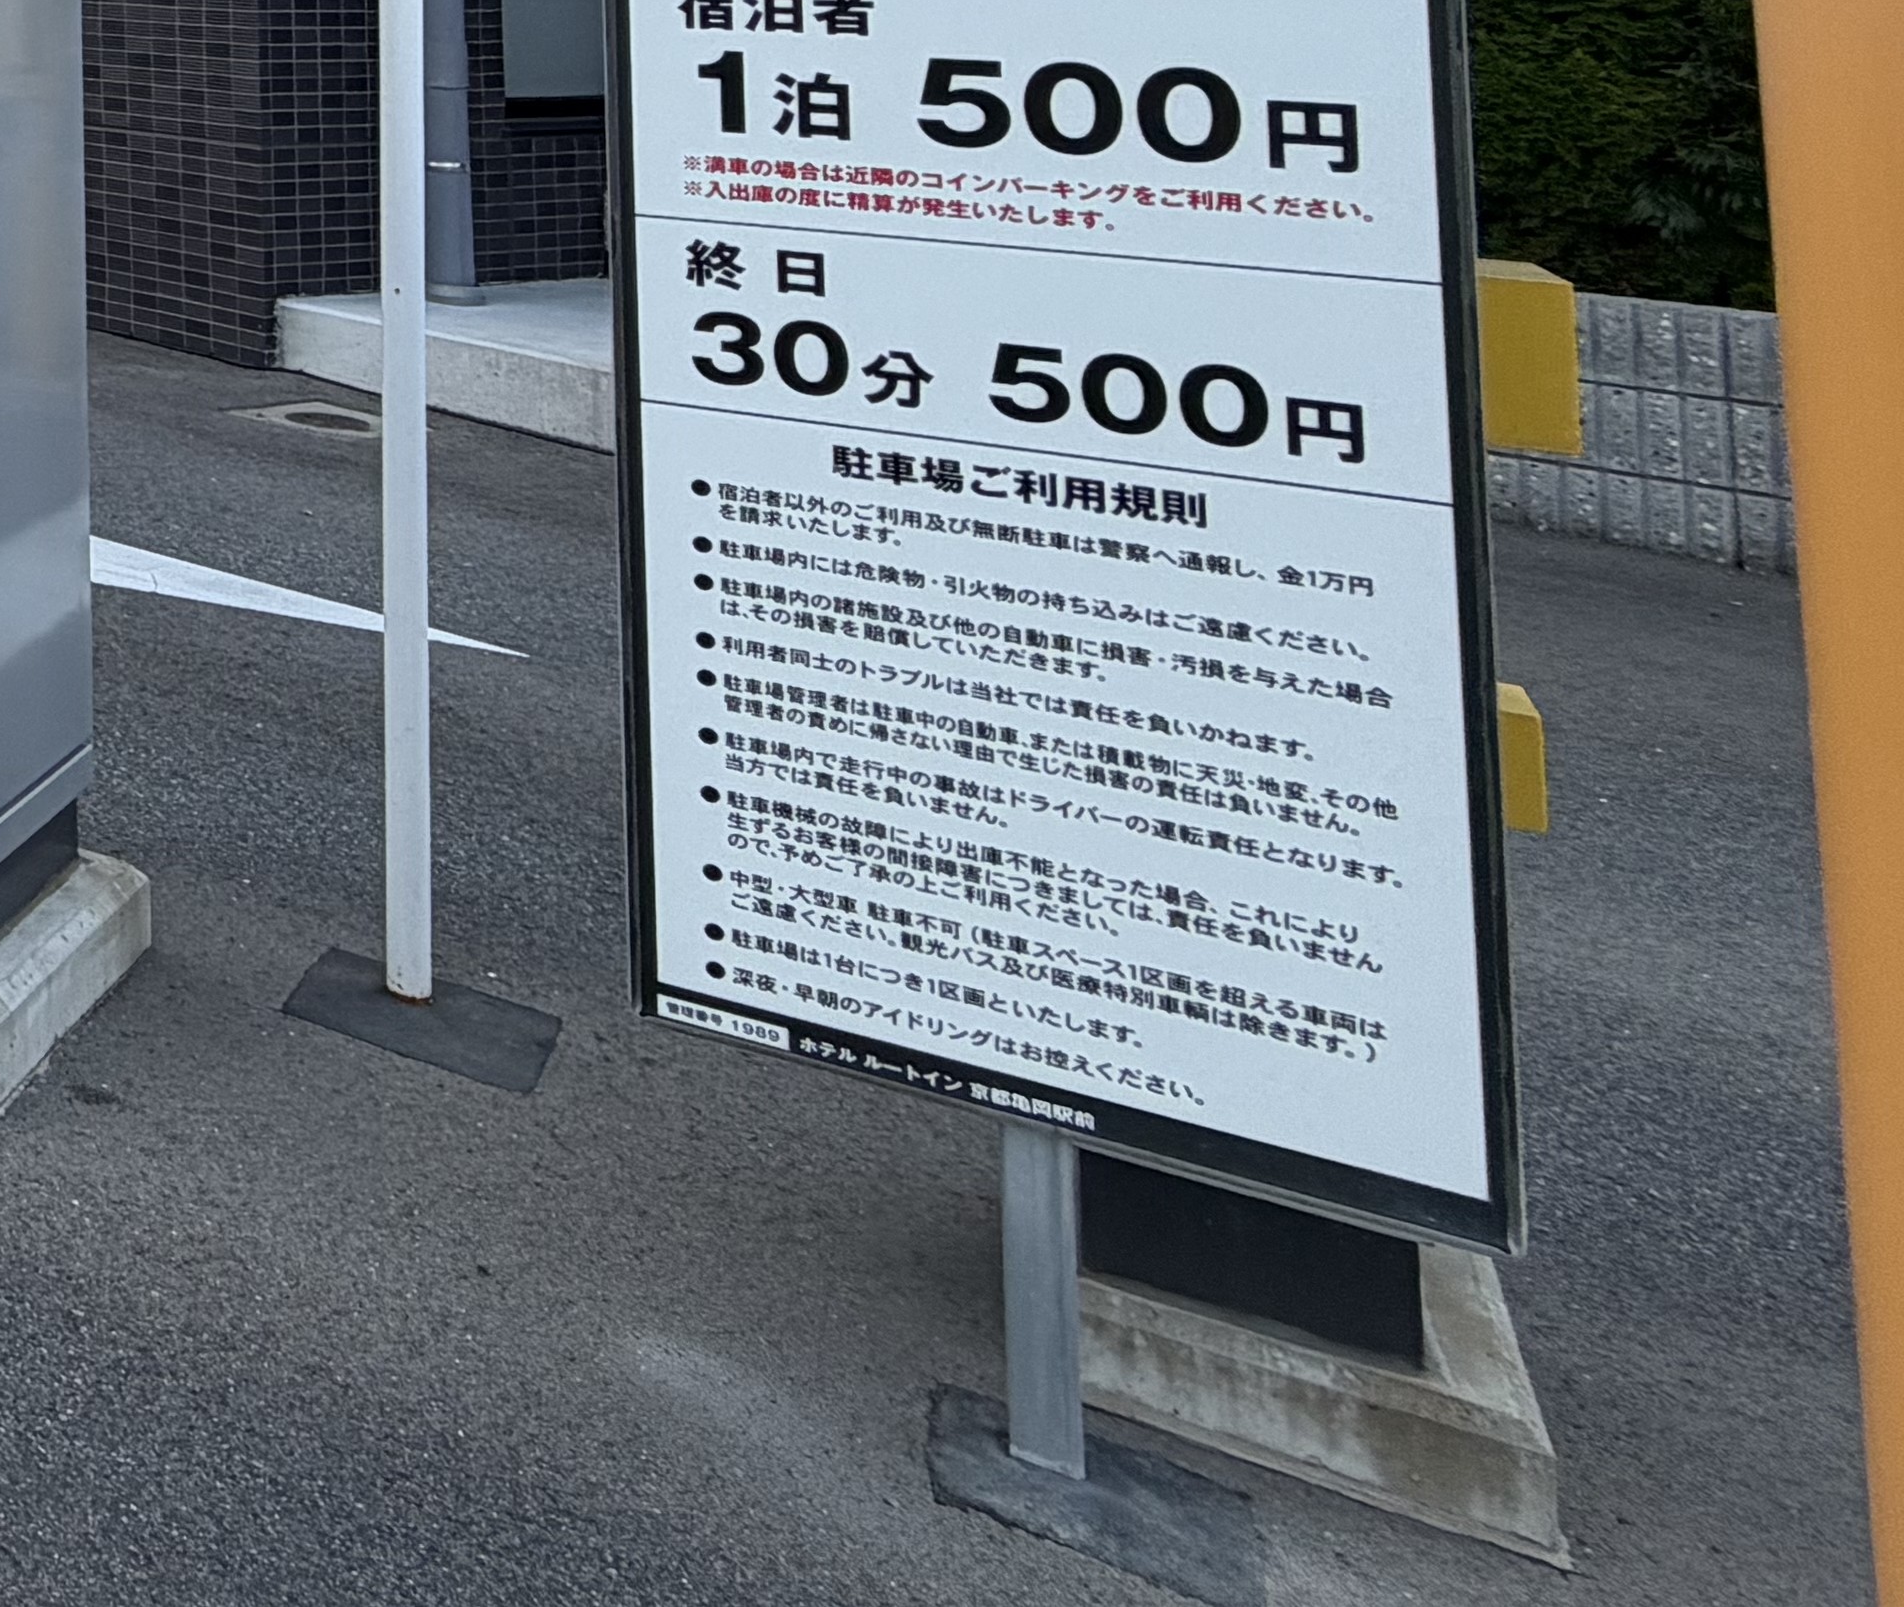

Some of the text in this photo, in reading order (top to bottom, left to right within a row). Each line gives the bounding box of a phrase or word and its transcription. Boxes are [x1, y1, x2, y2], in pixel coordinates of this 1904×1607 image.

[696, 50, 1360, 174] 1泊 500円
[690, 311, 1366, 465] 30分 500円
[832, 444, 1209, 529] 駐車場ご利用規則
[719, 504, 902, 546] を請求いたします。
[726, 753, 1008, 828] 当方では責任を負いません。
[731, 1019, 780, 1042] 1989
[799, 1036, 857, 1064] ホテル
[863, 1054, 963, 1092] ルートイン
